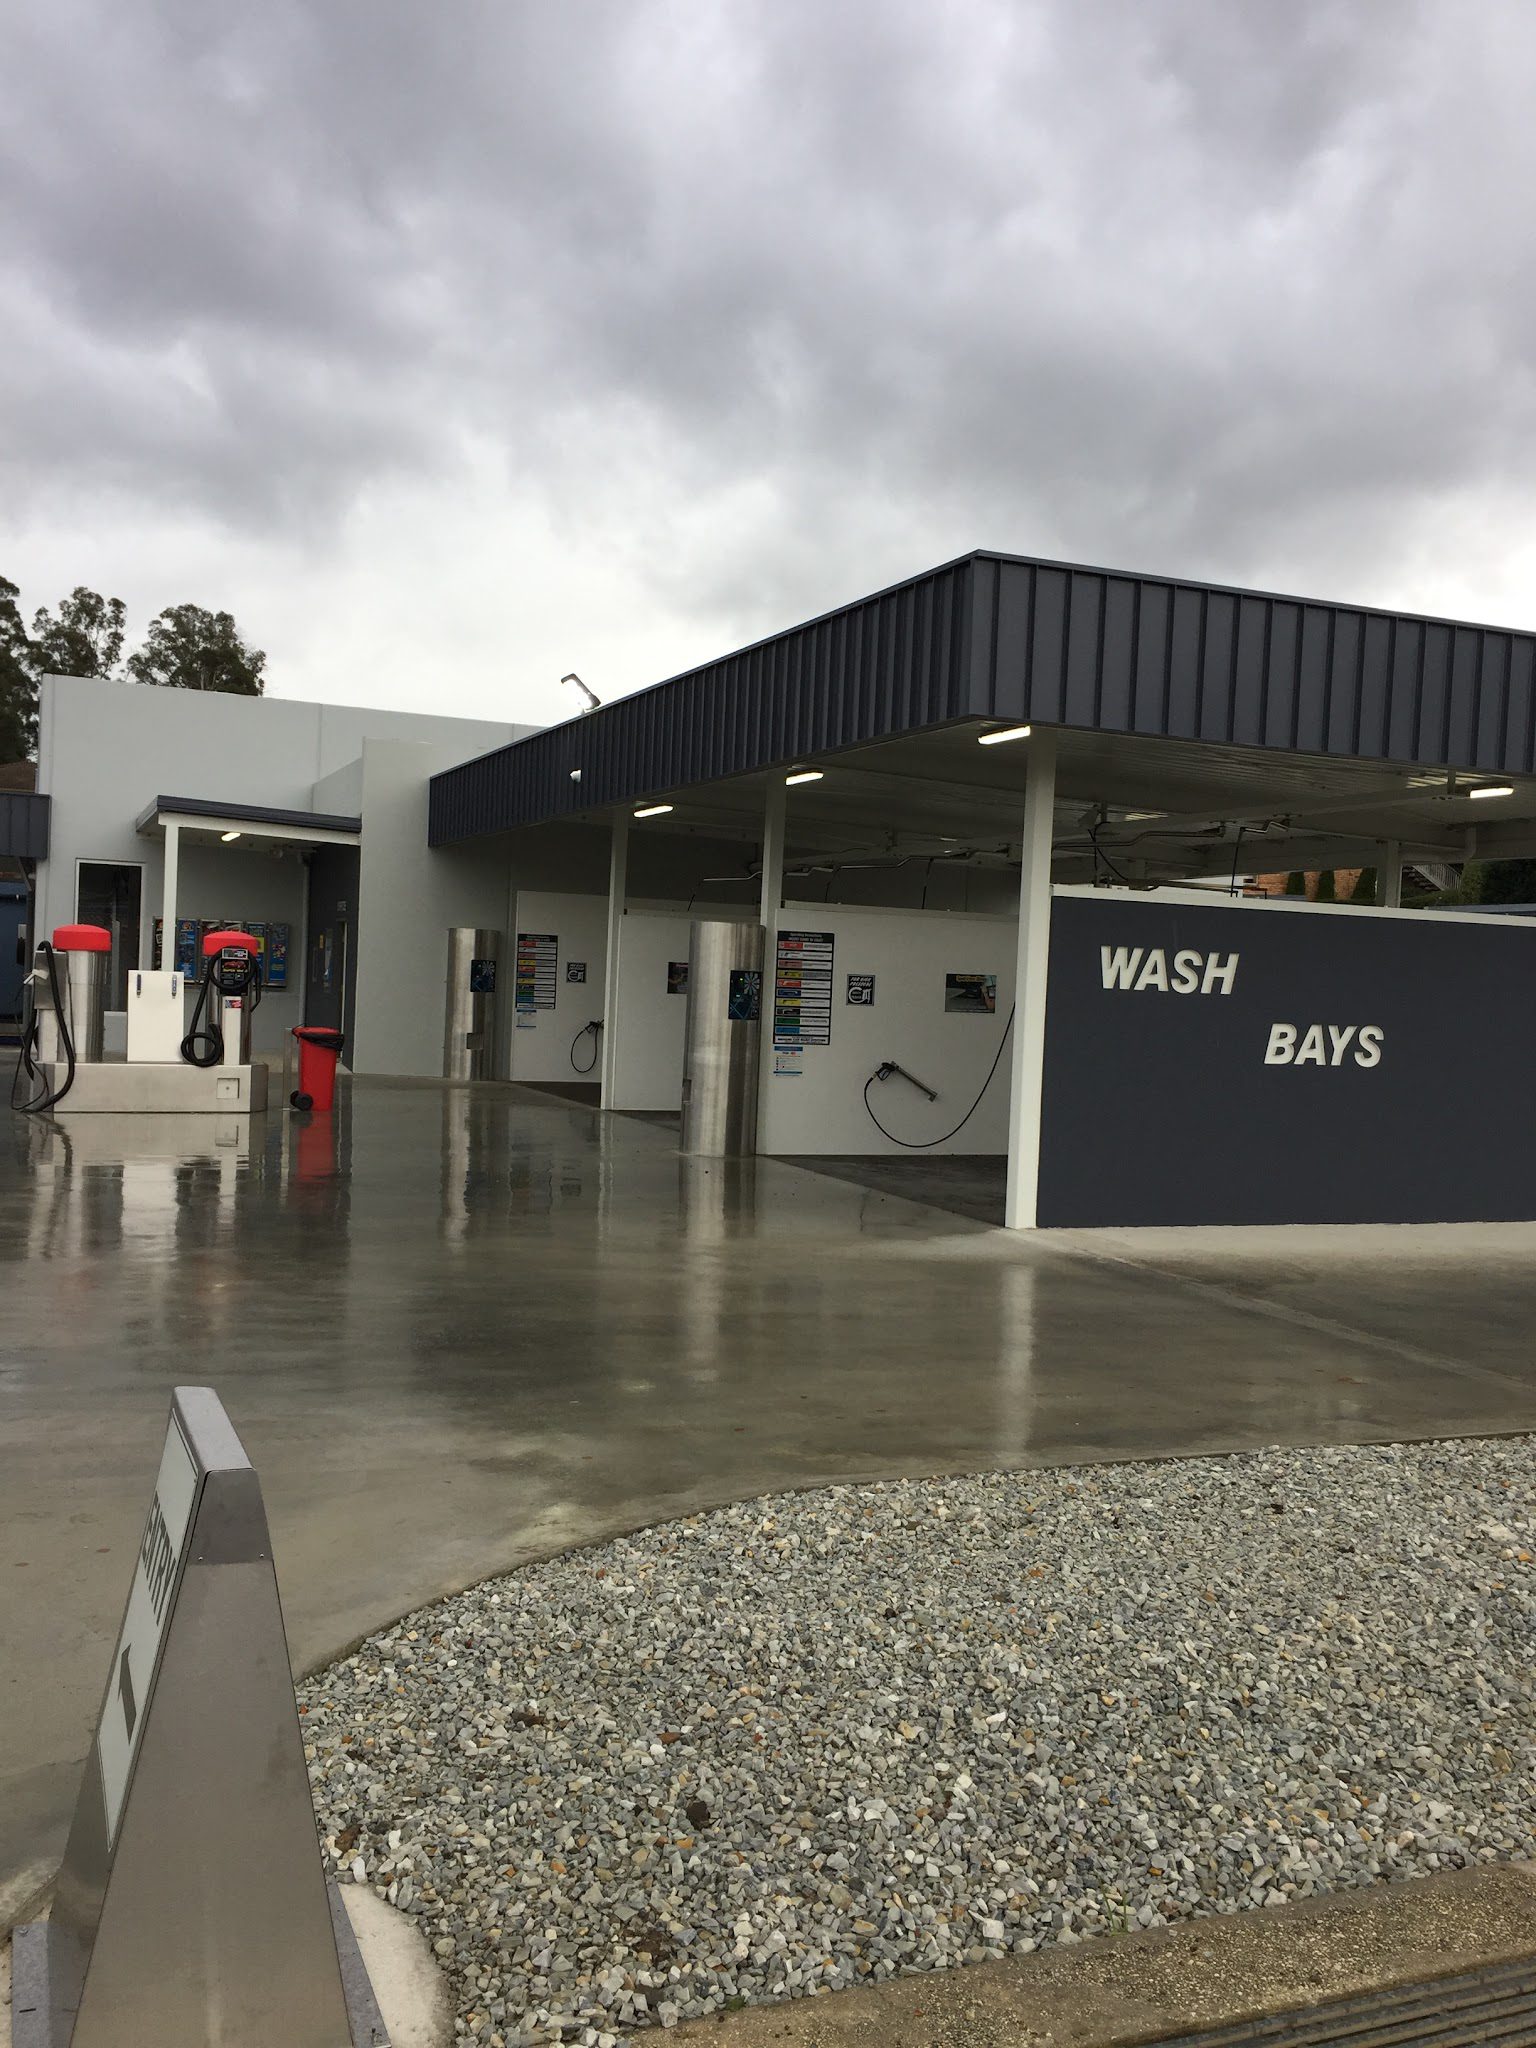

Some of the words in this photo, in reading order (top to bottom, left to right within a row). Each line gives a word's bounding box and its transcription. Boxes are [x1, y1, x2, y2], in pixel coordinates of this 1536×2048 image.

[1100, 946, 1240, 995] WASH
[1263, 1023, 1385, 1068] BAYS
[142, 1490, 176, 1627] ENTRY
